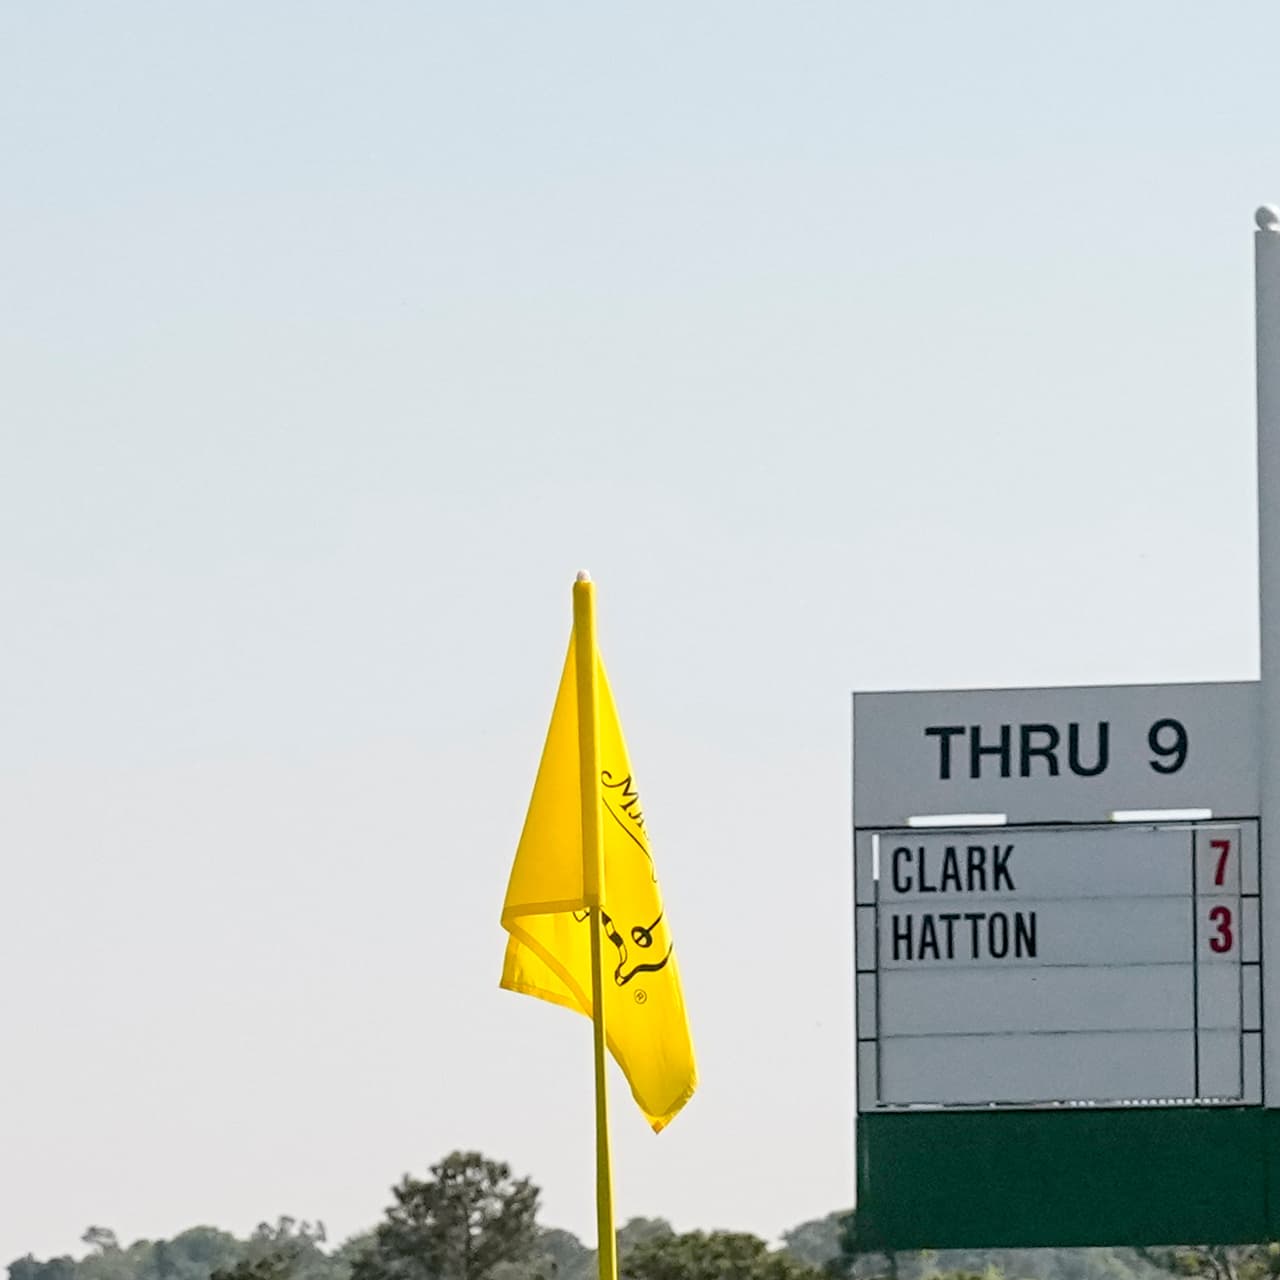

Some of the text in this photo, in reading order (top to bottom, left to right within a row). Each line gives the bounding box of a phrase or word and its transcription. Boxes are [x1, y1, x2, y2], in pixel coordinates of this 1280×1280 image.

[924, 718, 1189, 780] THRU 9
[891, 839, 1231, 894] CLARK 7
[891, 905, 1233, 961] HATTON 3
